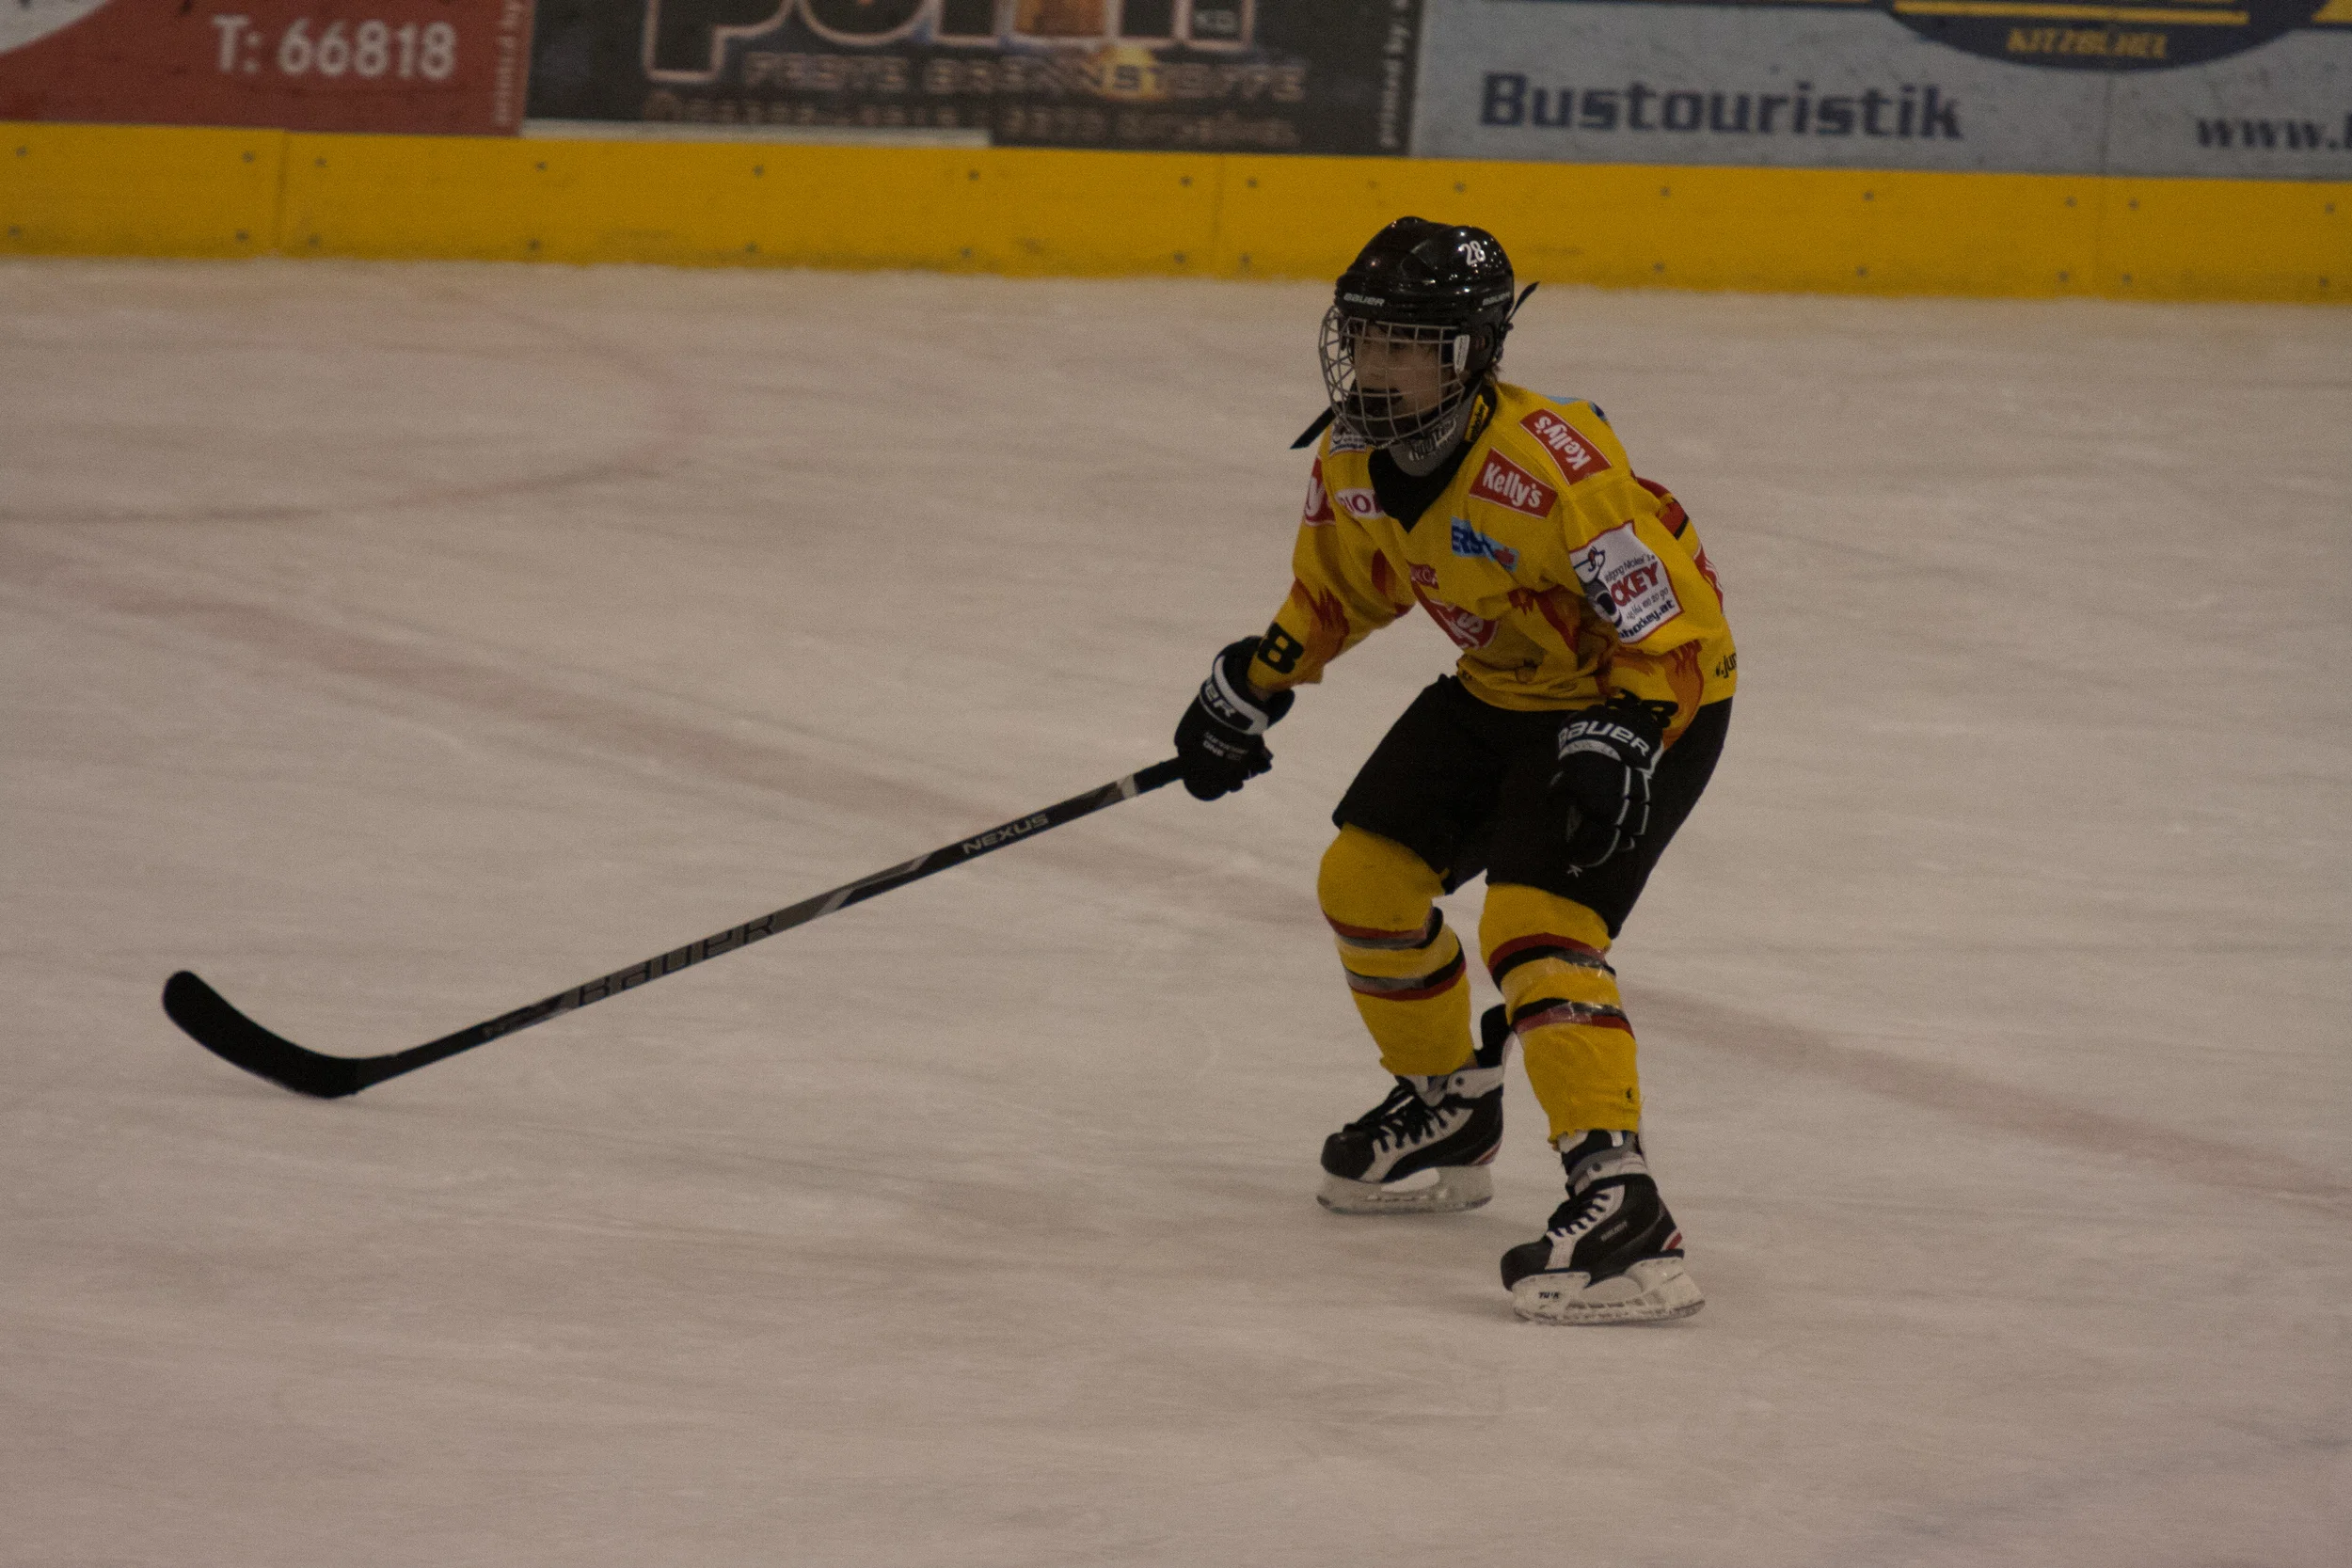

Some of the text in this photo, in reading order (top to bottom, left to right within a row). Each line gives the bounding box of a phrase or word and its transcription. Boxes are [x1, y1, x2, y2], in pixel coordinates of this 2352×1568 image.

[210, 14, 458, 81] T: 66818
[1480, 71, 1962, 140] Bustouristik
[1460, 240, 1487, 266] 28
[1533, 415, 1592, 471] Kelly's
[1481, 461, 1543, 509] Kelly's
[1557, 718, 1651, 758] BAUER
[962, 812, 1050, 855] NEXUS
